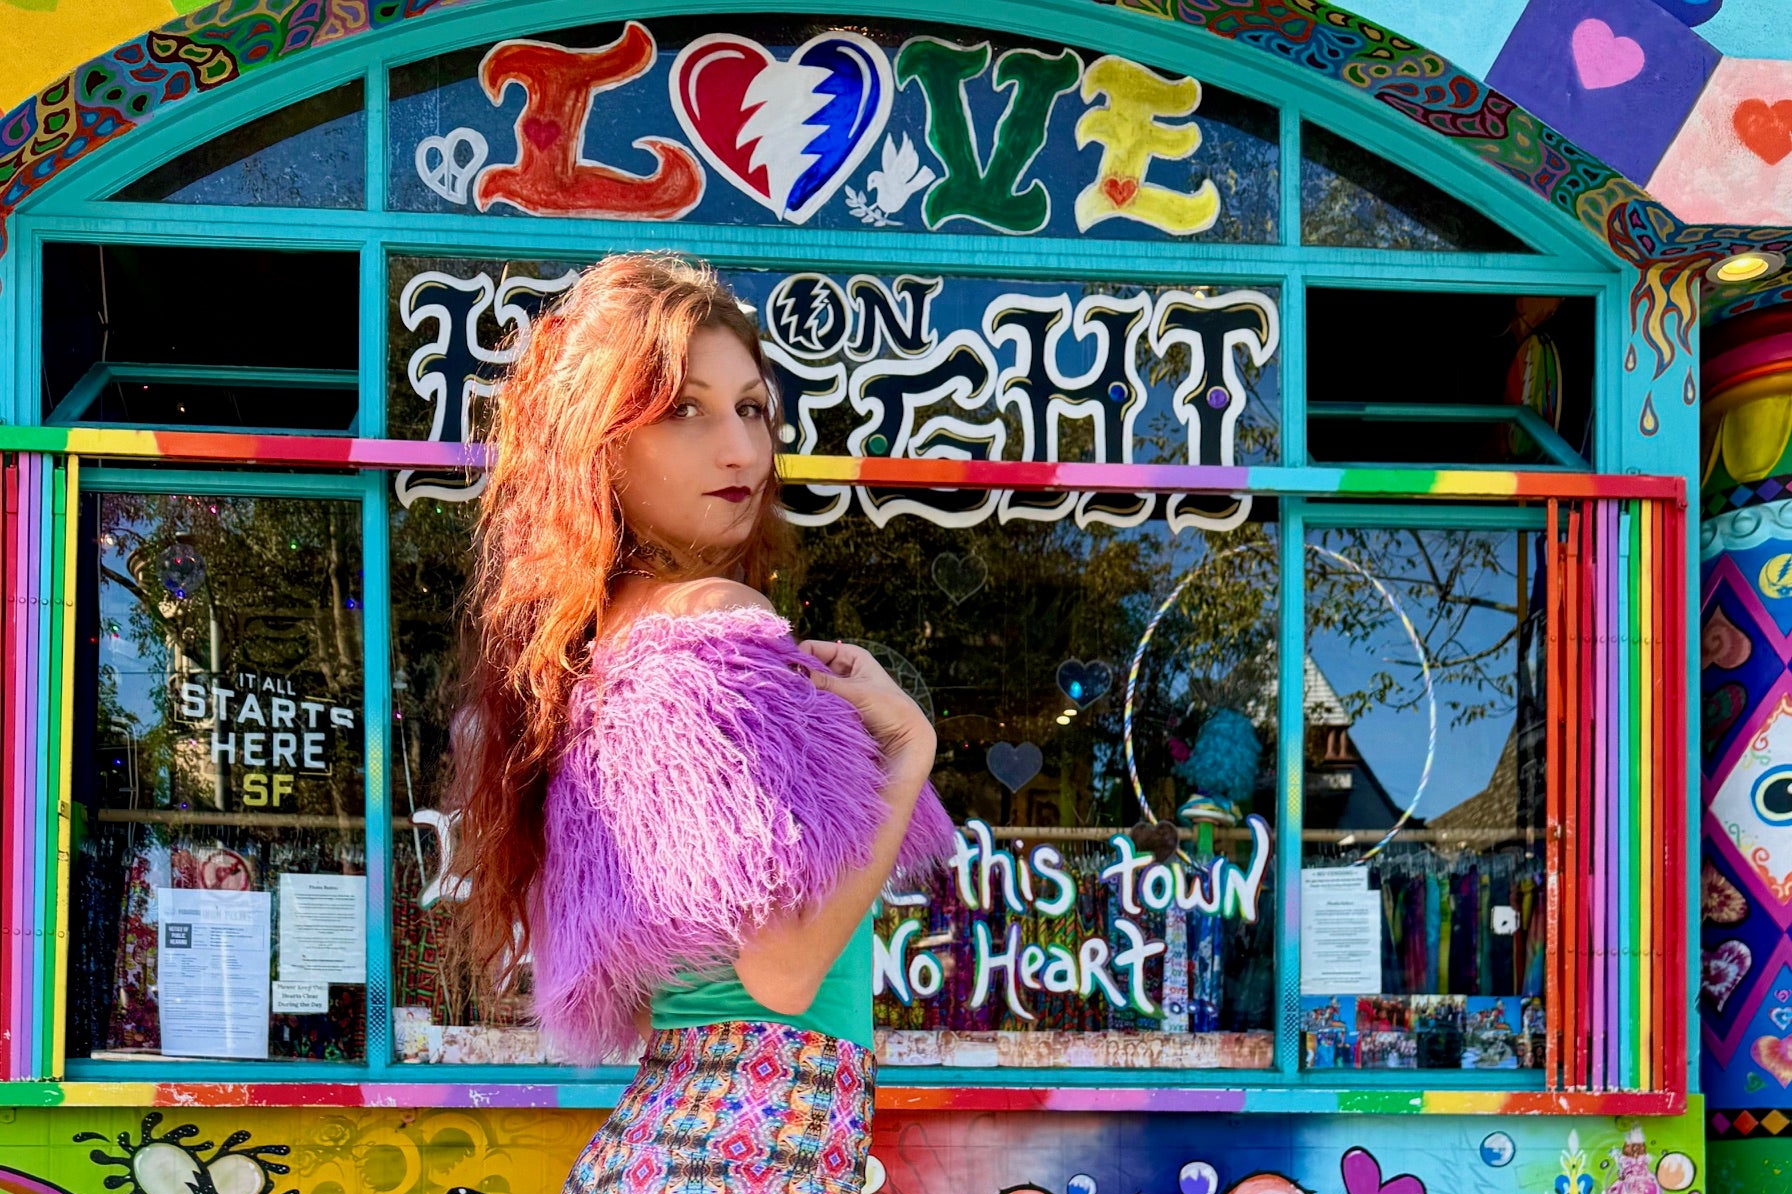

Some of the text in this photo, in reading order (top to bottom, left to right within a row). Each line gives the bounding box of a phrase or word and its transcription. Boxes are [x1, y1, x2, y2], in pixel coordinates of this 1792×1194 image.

[766, 272, 944, 362] ON
[395, 271, 1281, 534] HIGHT
[181, 682, 355, 728] STARTS
[239, 672, 296, 696] IT ALL
[210, 732, 326, 769] HERE
[242, 773, 295, 807] SF
[949, 817, 1076, 917] this
